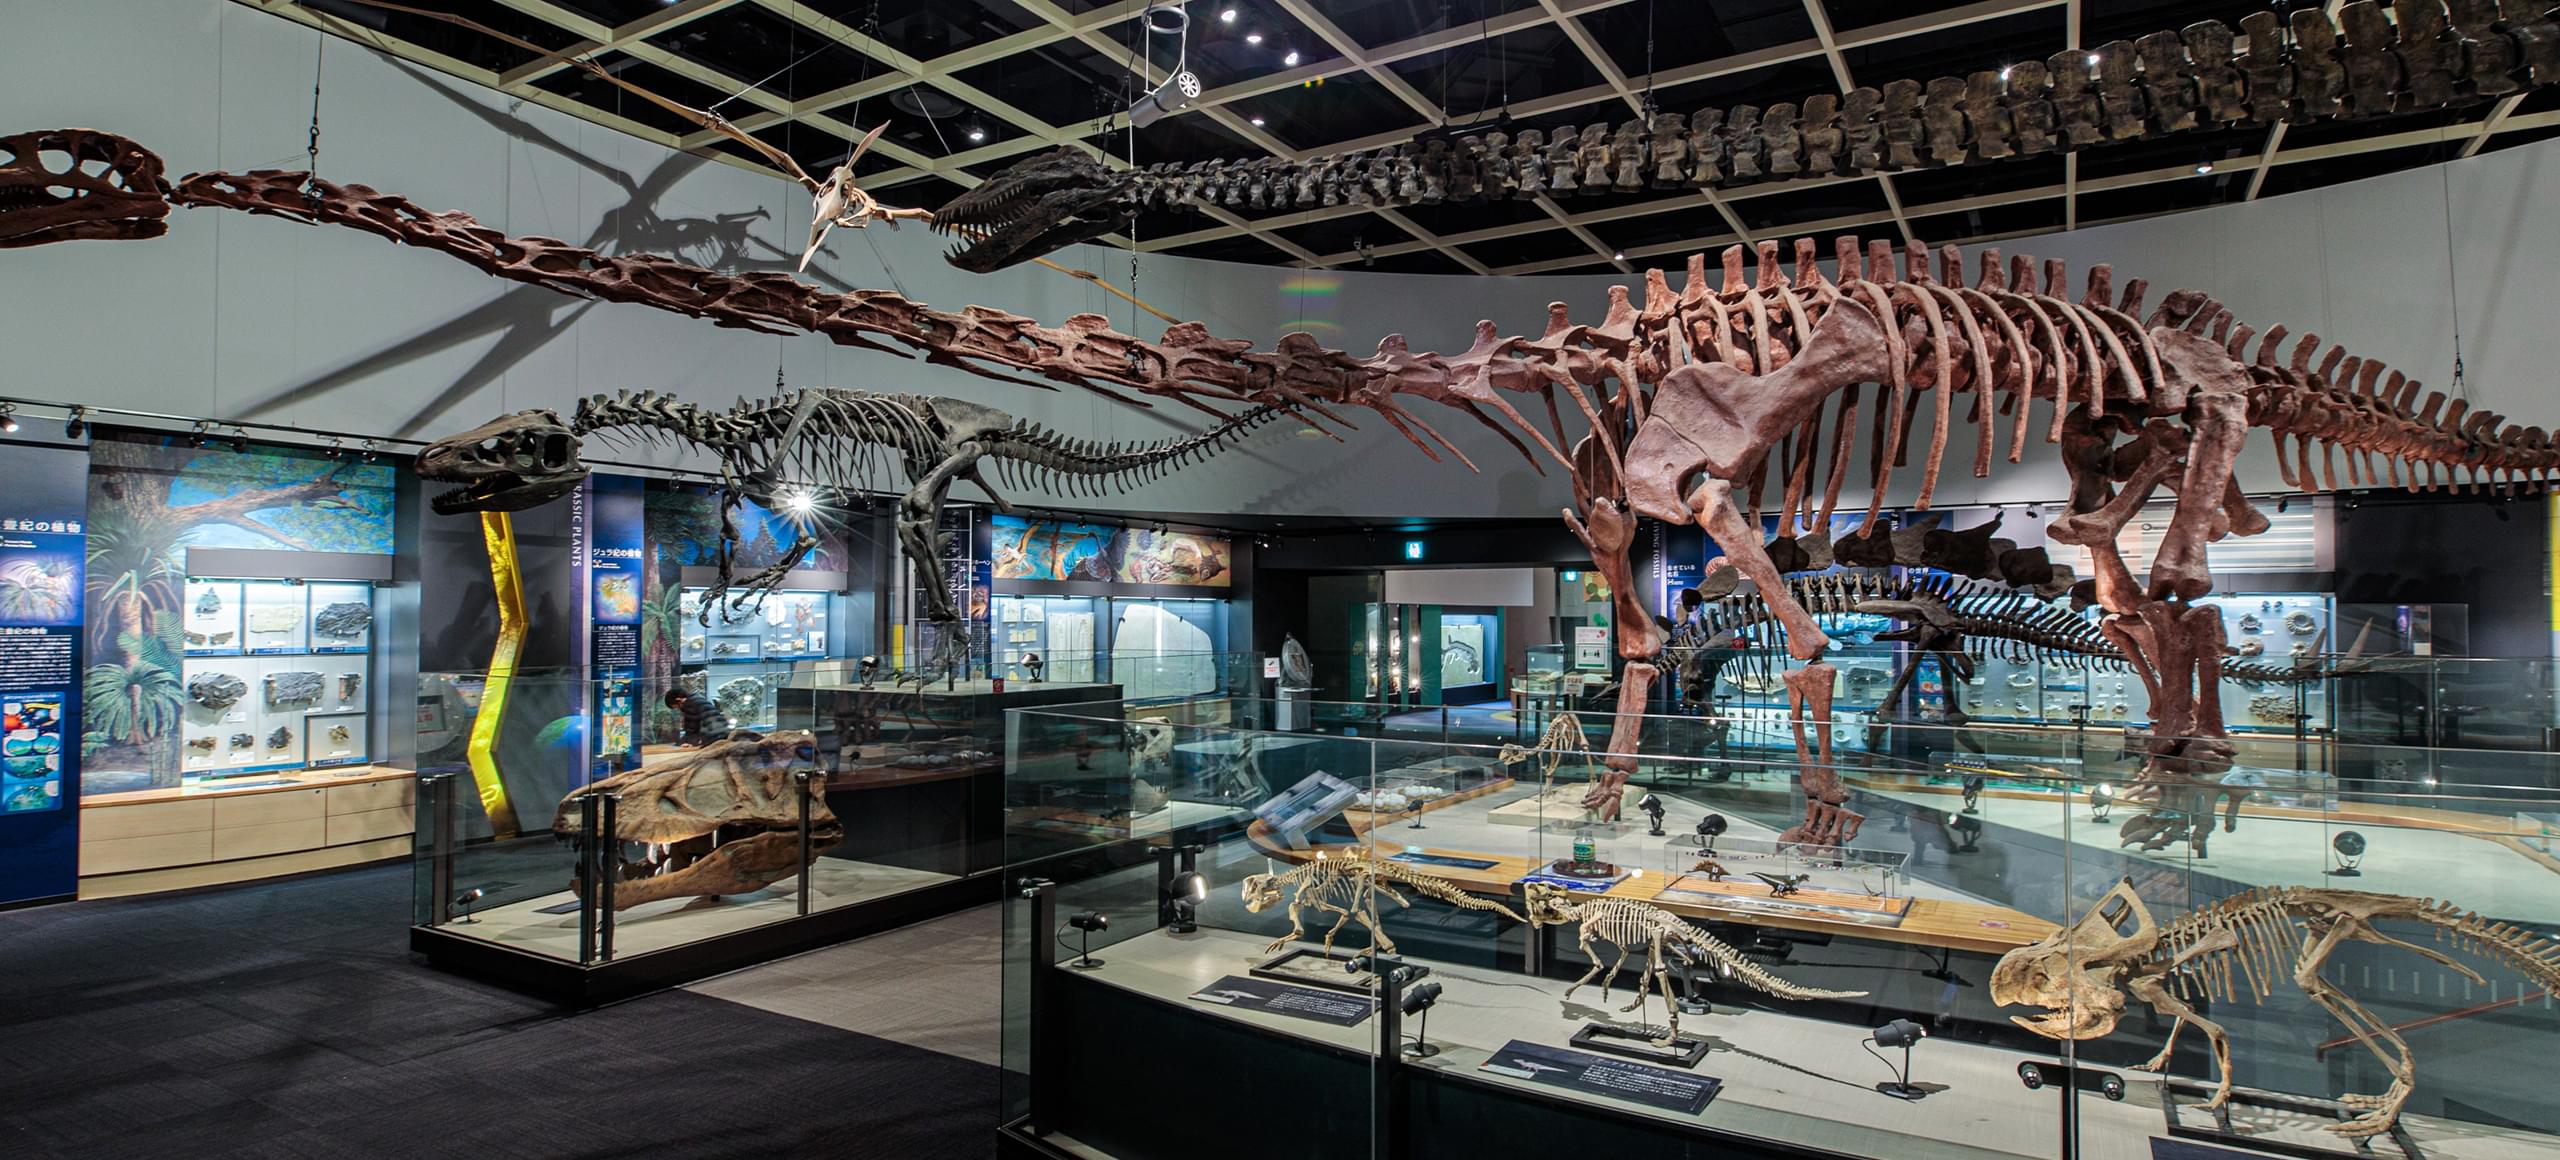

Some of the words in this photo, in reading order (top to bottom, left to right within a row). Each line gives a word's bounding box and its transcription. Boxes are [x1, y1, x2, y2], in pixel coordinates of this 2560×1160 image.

[572, 482, 583, 523] RASSIC
[2, 518, 81, 533] 畳紀の植物
[572, 526, 583, 567] PLANTS
[1652, 550, 1660, 578] FOSSILS
